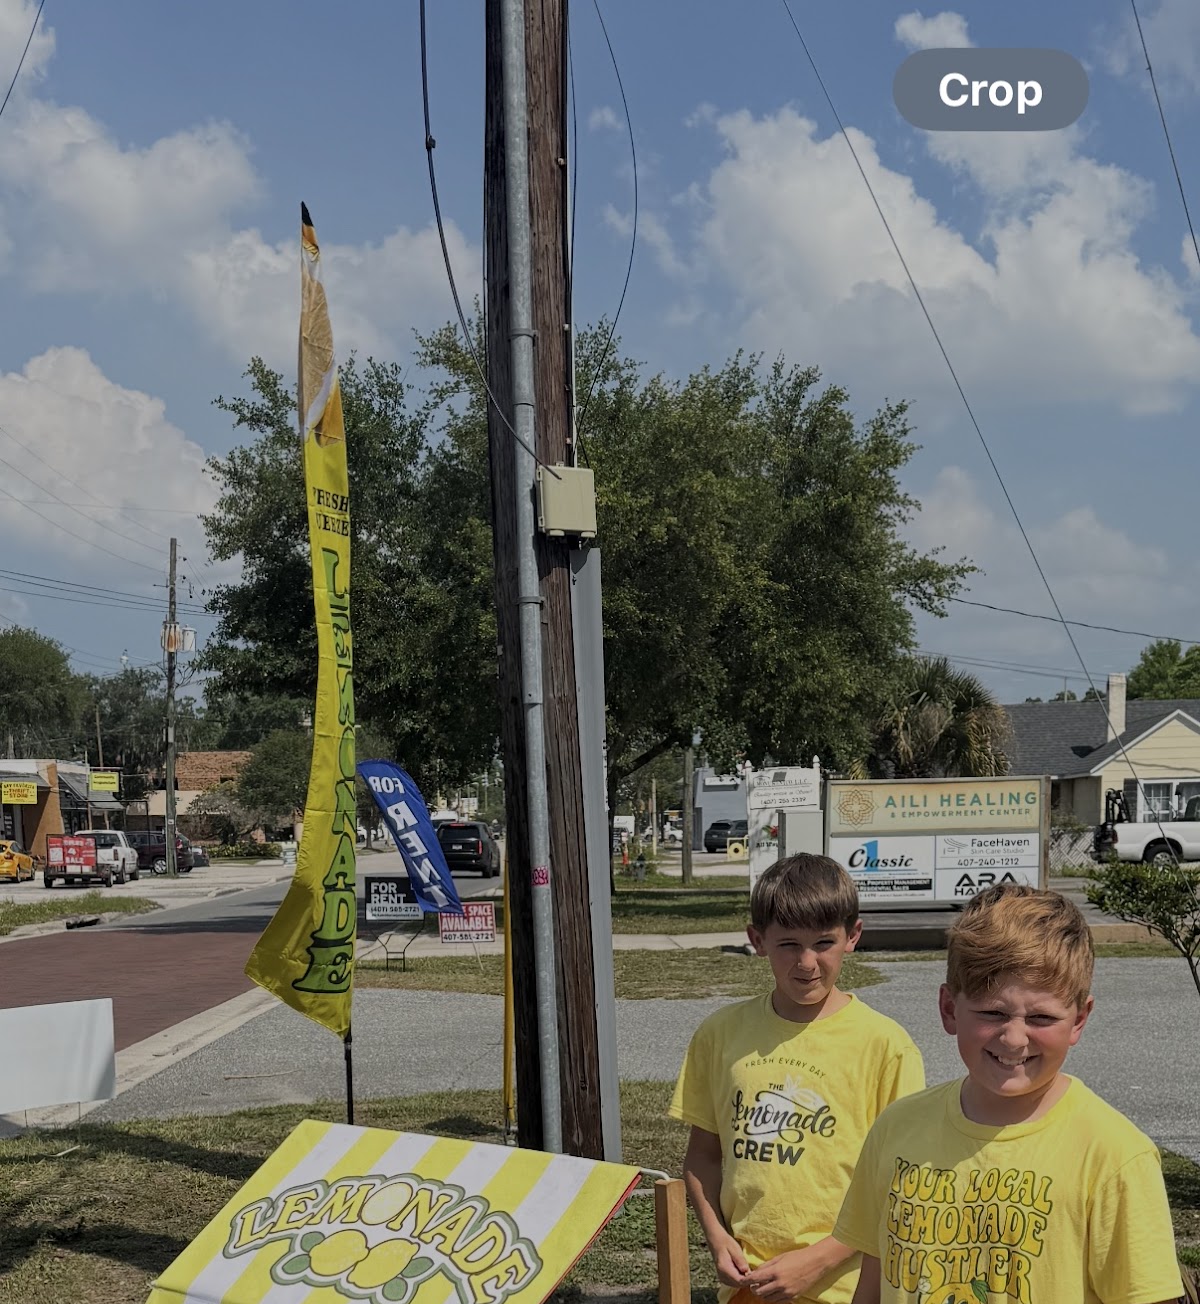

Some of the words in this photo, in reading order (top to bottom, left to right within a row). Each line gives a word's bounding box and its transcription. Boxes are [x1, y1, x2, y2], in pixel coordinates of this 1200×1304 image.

[313, 487, 349, 512] RESH
[885, 795, 928, 808] AILI
[940, 791, 1038, 807] HEALING
[902, 809, 984, 818] EMPOWERMENT
[989, 808, 1031, 816] CENTER
[971, 838, 1030, 848] FaceHaven
[848, 848, 914, 868] Classic
[957, 857, 1020, 867] 407-240-1212
[956, 872, 1018, 887] ARA
[370, 882, 398, 894] FOR
[370, 893, 407, 905] RENT
[468, 904, 493, 916] SPACE
[745, 1057, 775, 1069] FRESH
[778, 1057, 808, 1069] EVERY
[809, 1065, 827, 1079] DAY
[768, 1082, 785, 1092] THE
[733, 1138, 806, 1166] CREW
[891, 1157, 957, 1203] YOUR
[963, 1168, 1053, 1215] LOCAL
[887, 1193, 1047, 1257] LEMONADE
